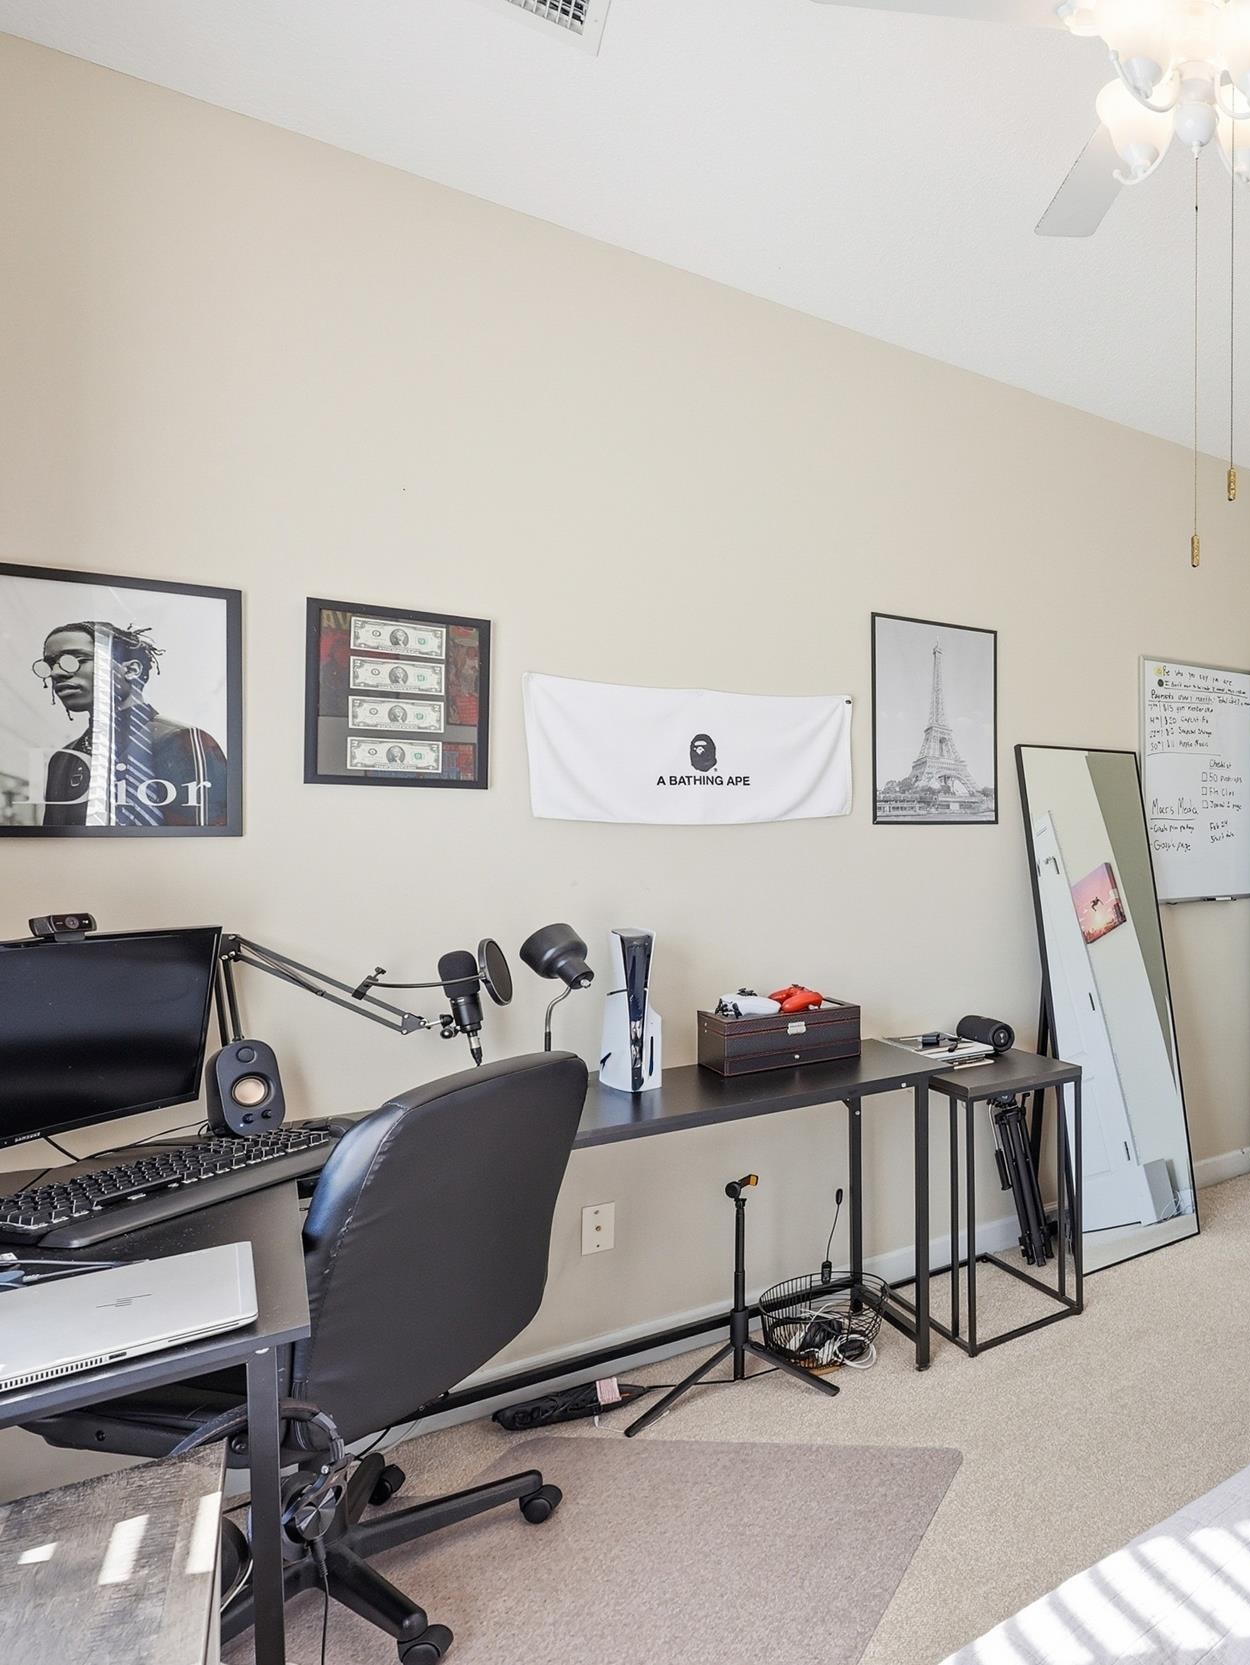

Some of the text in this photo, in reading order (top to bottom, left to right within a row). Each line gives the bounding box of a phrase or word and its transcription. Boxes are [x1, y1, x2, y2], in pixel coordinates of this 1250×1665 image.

[12, 748, 212, 807] Dior
[656, 775, 751, 786] A BATHING APE
